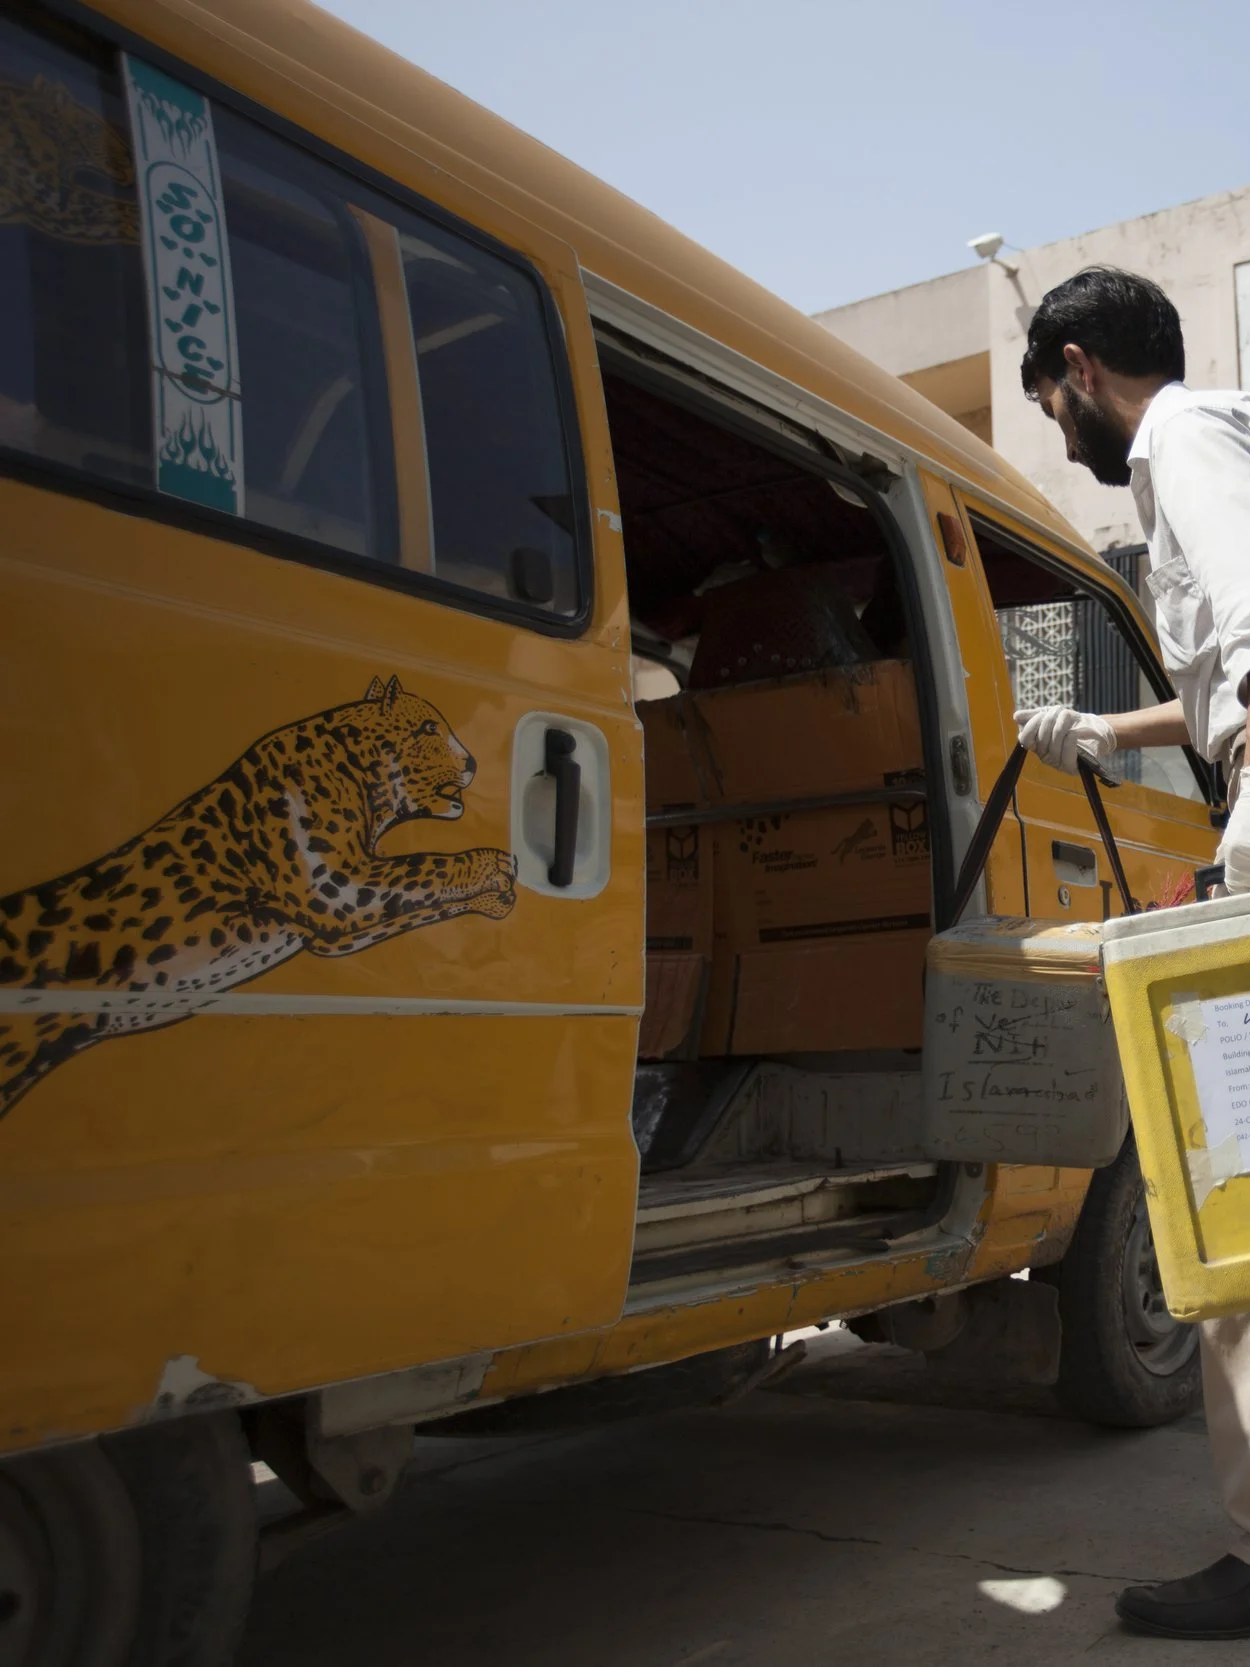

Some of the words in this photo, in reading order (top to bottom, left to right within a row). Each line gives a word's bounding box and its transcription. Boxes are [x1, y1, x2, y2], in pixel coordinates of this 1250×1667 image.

[895, 840, 928, 856] BOX
[752, 849, 795, 864] Faster
[1214, 1000, 1244, 1012] Booking
[1220, 1034, 1242, 1045] POLIO
[1231, 1101, 1248, 1110] EDO
